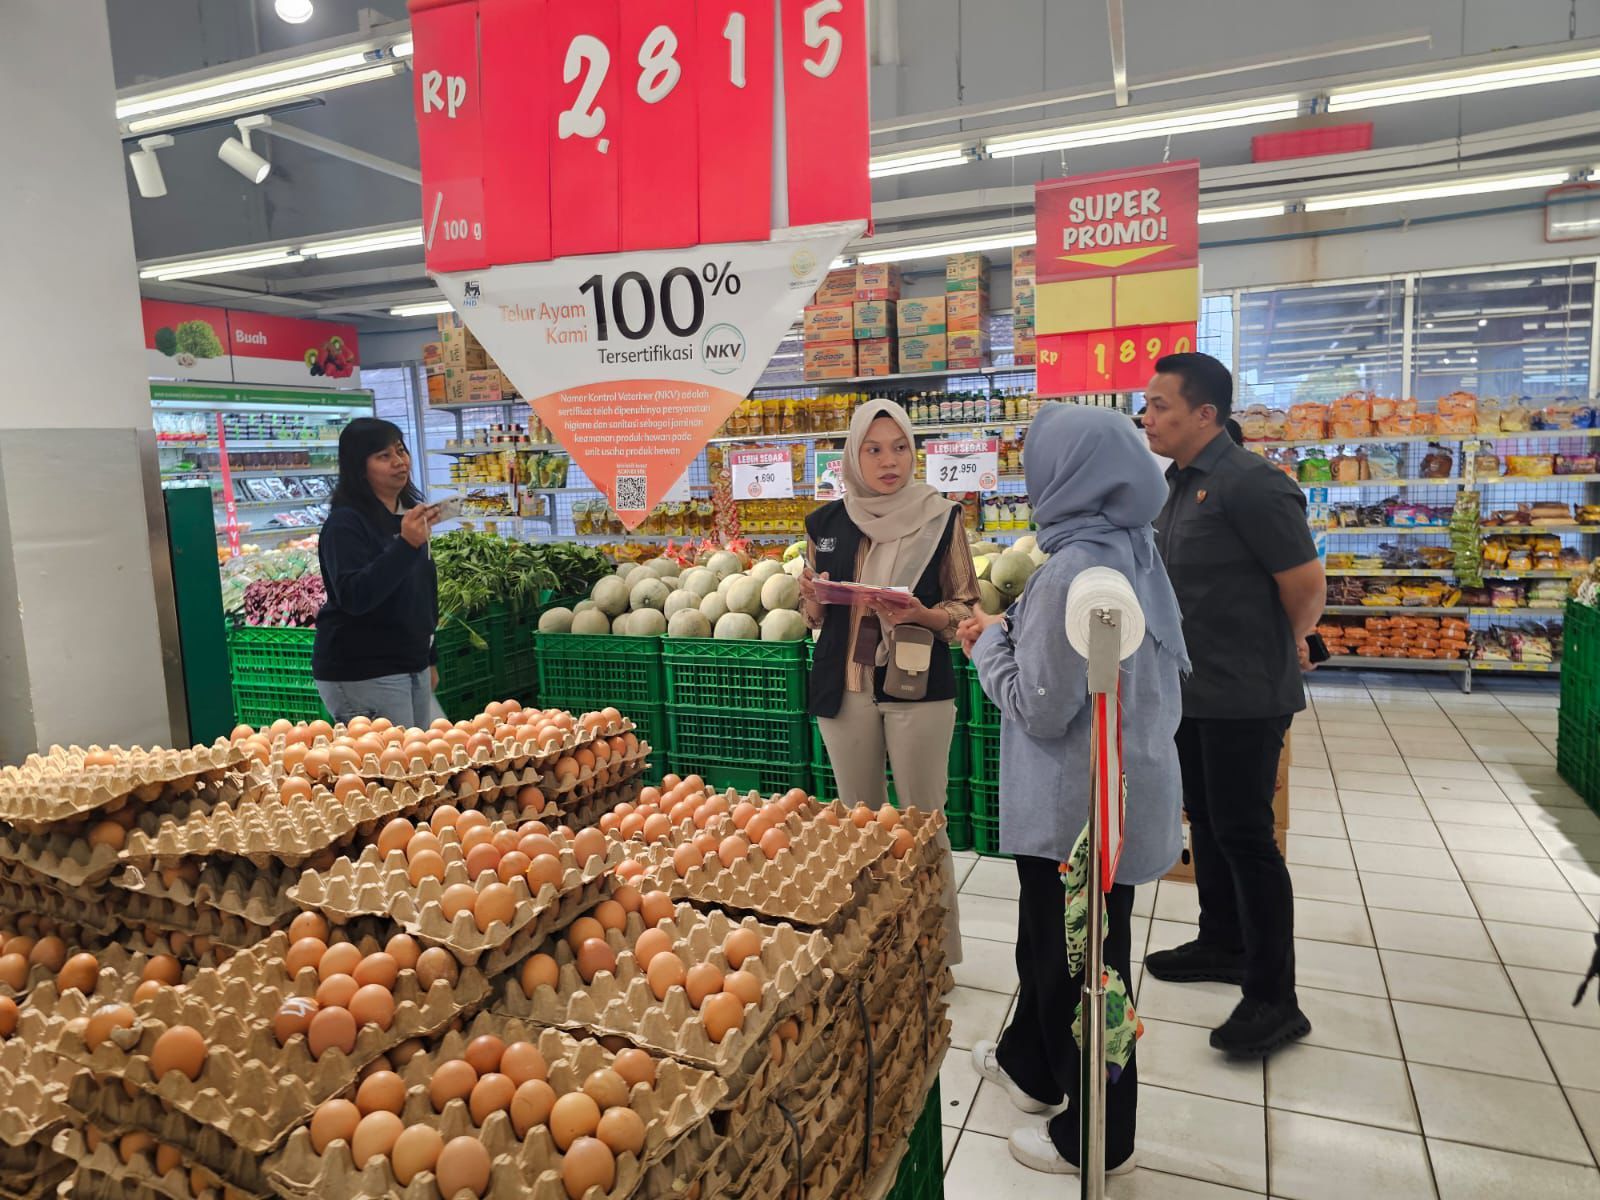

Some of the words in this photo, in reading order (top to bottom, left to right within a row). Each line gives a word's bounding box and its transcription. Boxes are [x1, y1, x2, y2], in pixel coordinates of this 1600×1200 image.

[422, 70, 466, 118] Rp
[1069, 187, 1161, 223] SUPER
[473, 223, 482, 241] g
[1063, 217, 1168, 250] PROMO!
[579, 261, 741, 341] 100%
[500, 304, 536, 322] Telur
[539, 303, 586, 323] Ayam
[235, 329, 268, 346] Buah
[546, 325, 588, 345] Kami
[598, 344, 693, 365] Tersertifikasi
[706, 343, 742, 359] NKV
[1040, 350, 1058, 365] Rp
[588, 392, 617, 403] Kontrol
[655, 389, 680, 402] (NKV)
[564, 420, 592, 431] higiene
[593, 420, 607, 429] dan
[609, 419, 639, 429] sanitasi
[640, 418, 670, 430] sebagai
[615, 433, 642, 444] produk
[601, 446, 625, 456] usaha
[626, 446, 653, 458] produk
[655, 446, 680, 456] hewan
